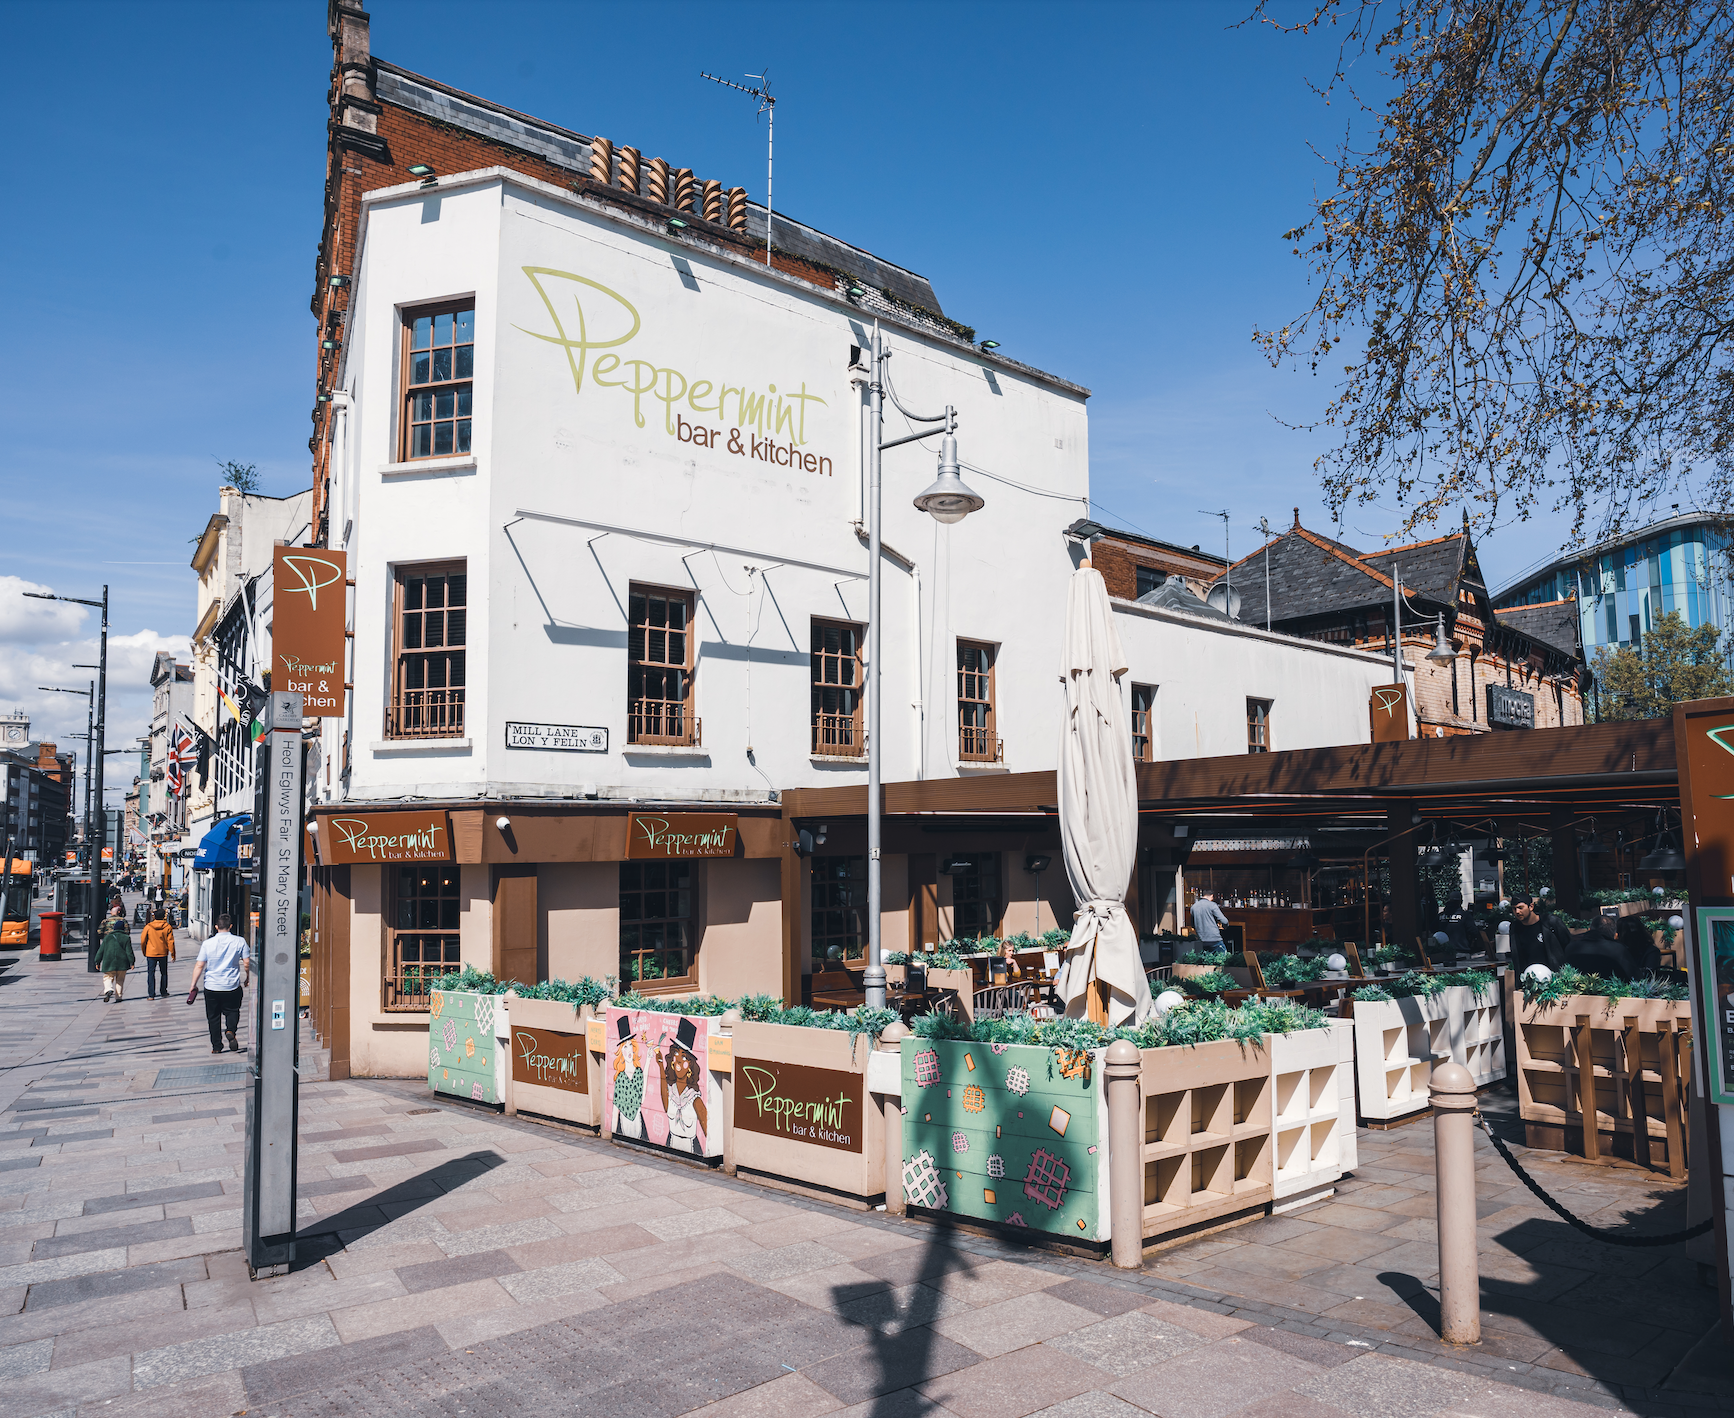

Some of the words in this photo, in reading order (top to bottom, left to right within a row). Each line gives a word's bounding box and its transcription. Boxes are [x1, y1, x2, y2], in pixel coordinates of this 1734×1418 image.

[510, 266, 828, 446] Peppermint
[677, 414, 721, 449] bar
[727, 428, 746, 456] &
[751, 433, 834, 477] kitchen
[279, 654, 339, 677] Peppermint
[287, 679, 313, 692] bar
[318, 680, 330, 693] &
[512, 726, 541, 736] MILL
[547, 728, 578, 737] LANE
[512, 736, 535, 745] LON
[541, 737, 549, 746] Y
[553, 738, 587, 747] FELIN
[282, 740, 294, 768] Heol
[278, 771, 293, 815] Eglwys
[279, 819, 292, 842] Fair
[332, 818, 443, 859] Peppermint
[635, 817, 734, 855] Peppermint
[279, 849, 291, 862] St
[388, 851, 402, 859] bar
[414, 850, 444, 858] kitchen
[276, 866, 290, 896] Mary
[277, 899, 289, 937] Street
[517, 1032, 582, 1081] Peppermint
[742, 1066, 853, 1132] Peppermint
[793, 1123, 807, 1136] bar
[809, 1126, 816, 1138] &
[819, 1127, 851, 1145] kitchen
